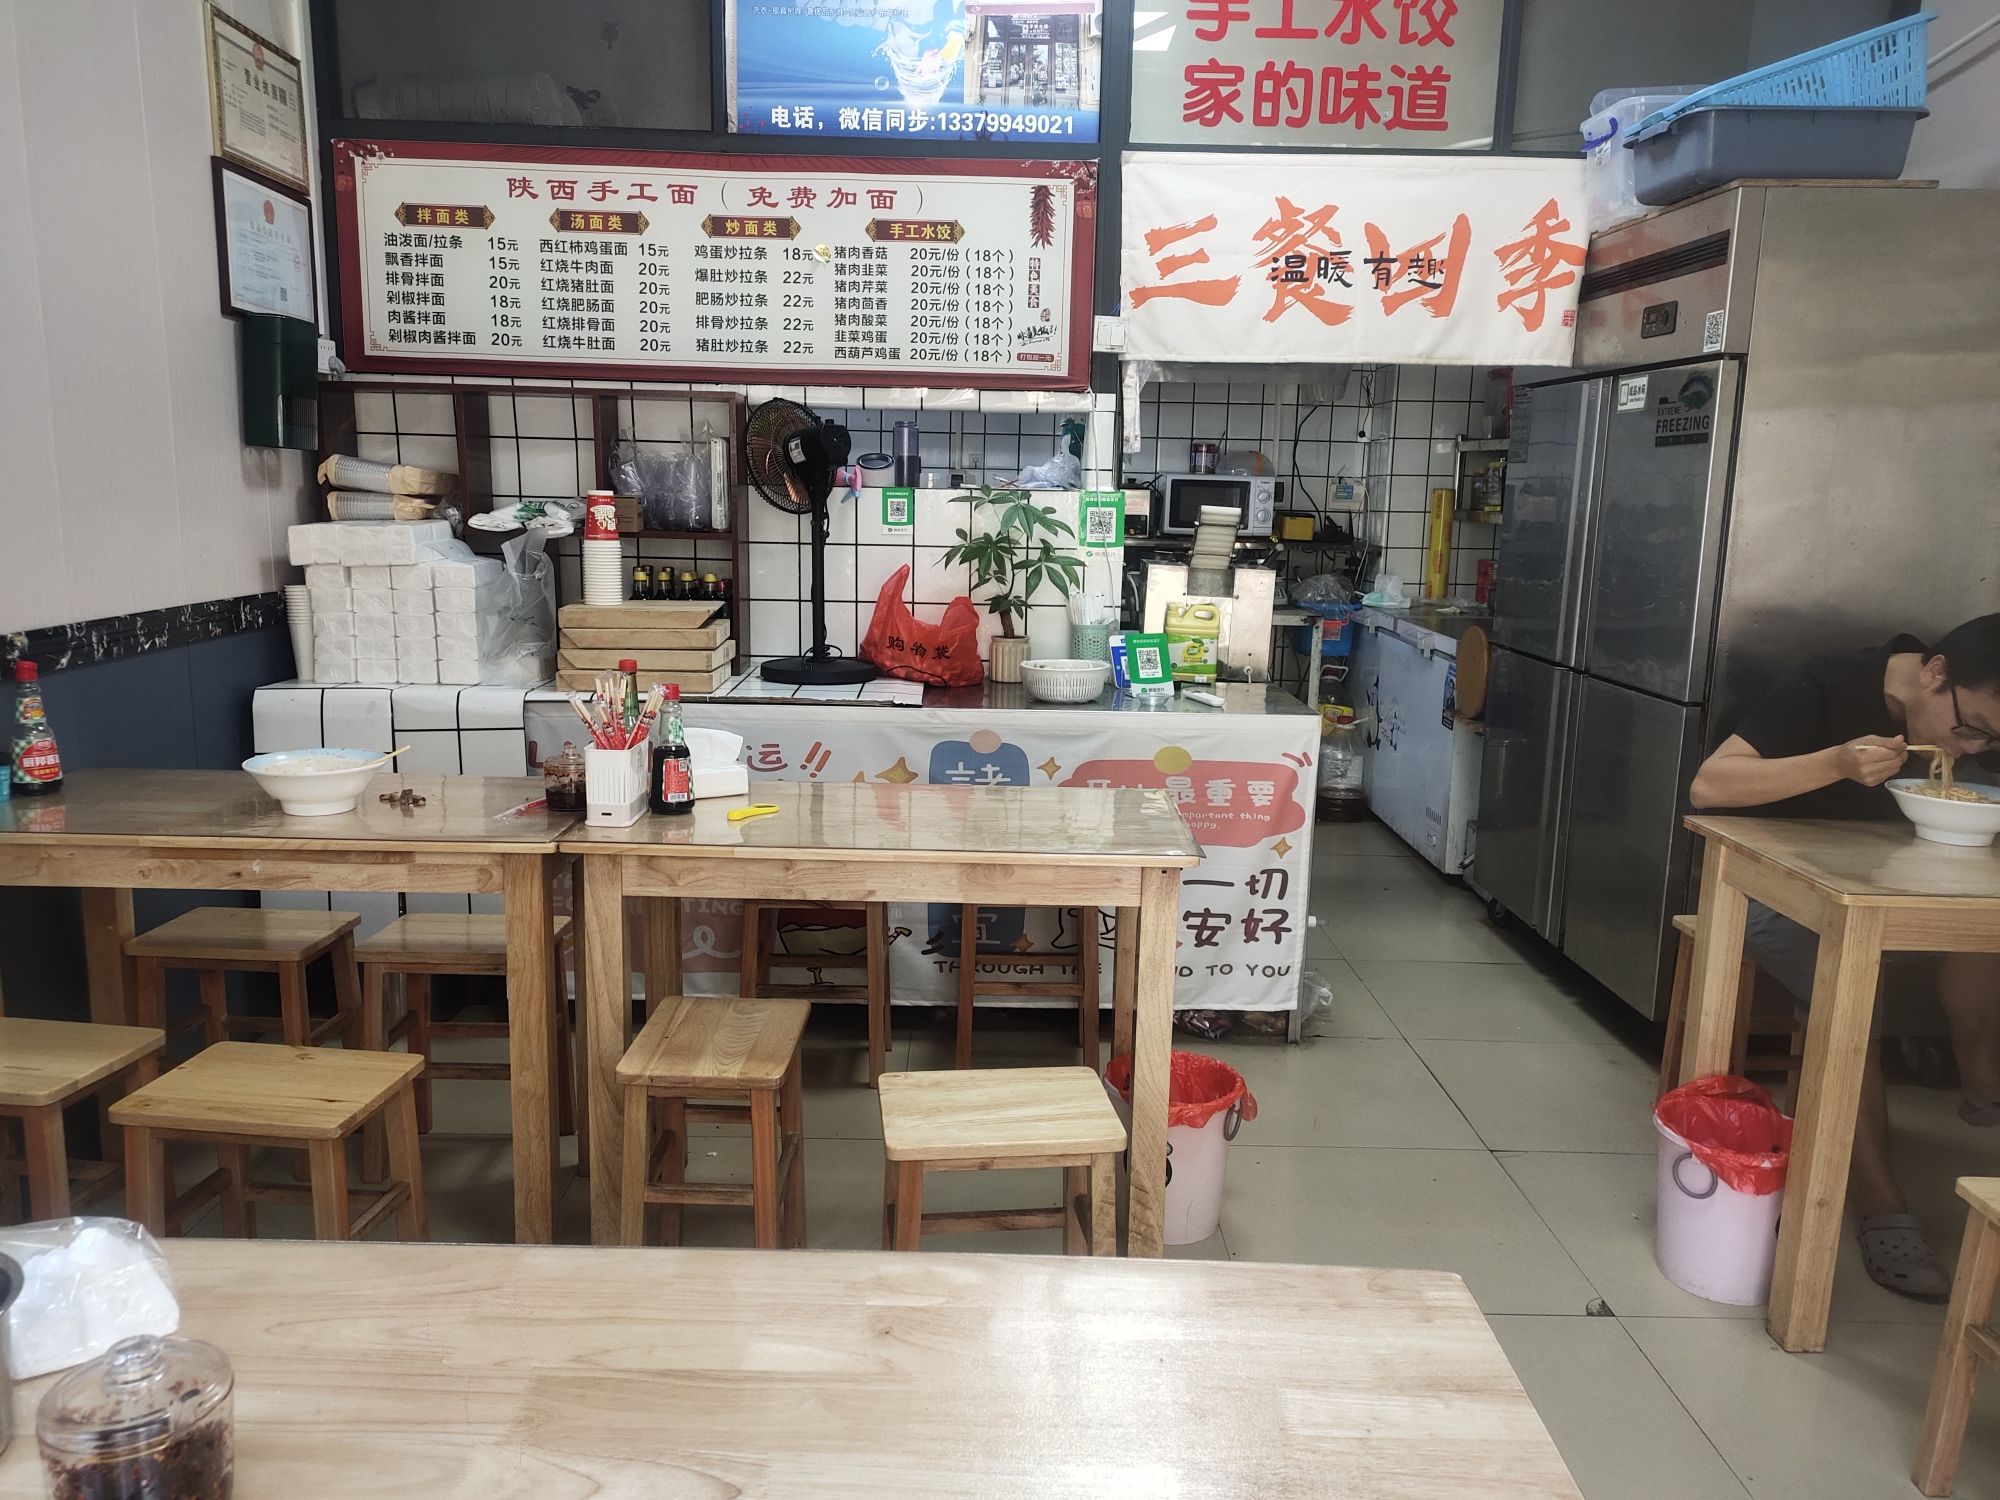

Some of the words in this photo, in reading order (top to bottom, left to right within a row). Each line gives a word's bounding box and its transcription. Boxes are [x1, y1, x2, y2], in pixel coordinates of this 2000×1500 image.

[1183, 57, 1452, 131] 家的味道
[416, 207, 469, 225] 拌面类
[570, 212, 623, 231] 汤面类
[725, 218, 778, 237] 炒面类
[889, 223, 952, 241] 手工水饺
[384, 232, 462, 249] 油泼面/拉条
[488, 237, 518, 251] 15元
[539, 239, 627, 256] 西红柿鸡蛋面
[639, 243, 668, 257] 15元
[385, 252, 443, 268] 飘香拌面
[489, 256, 519, 270] 15元
[695, 245, 767, 260] 鸡蛋炒拉条
[783, 248, 813, 260] 18元
[835, 246, 887, 259] 猪肉香菇
[540, 258, 613, 274] 红烧牛肉面
[639, 263, 669, 276] 20元
[835, 263, 887, 276] 猪肉韭菜
[1129, 196, 1587, 332] 三餐四季
[1271, 250, 1445, 290] 温暖有趣
[386, 271, 444, 287] 排骨拌面
[490, 276, 520, 289] 20元
[695, 268, 767, 283] 爆肚炒拉条
[783, 271, 813, 284] 22元
[541, 278, 614, 294] 红烧猪肚面
[639, 282, 670, 295] 20元
[835, 280, 887, 293] 猪肉芹菜
[387, 290, 445, 306] 剁椒拌面
[491, 295, 521, 308] 18元
[542, 297, 614, 313] 红烧肥肠面
[640, 301, 670, 314] 20元
[696, 292, 768, 307] 肥肠炒拉条
[783, 295, 813, 307] 22元
[835, 297, 887, 310] 猪肉茴香
[388, 309, 446, 325] 肉酱拌面
[491, 314, 521, 328] 18元
[542, 316, 615, 332] 红烧排骨面
[640, 320, 670, 333] 20元
[696, 315, 768, 330] 排骨炒拉条
[783, 318, 813, 331] 22元
[835, 313, 887, 326] 猪肉酸菜
[387, 328, 476, 345] 剁椒肉酱拌面
[492, 333, 522, 347] 20元
[543, 335, 615, 350] 红烧牛肚面
[640, 339, 670, 352] 20元
[835, 330, 887, 343] 韭菜鸡蛋
[696, 338, 768, 353] 猪肚炒拉条
[783, 341, 813, 354] 22元
[835, 347, 900, 360] 西葫芦鸡蛋
[1656, 415, 1710, 433] FREEZING
[886, 635, 951, 660] 购物袋
[1182, 811, 1234, 821] mportant
[1240, 812, 1271, 821] thing
[1188, 822, 1221, 830] appy.
[1182, 868, 1289, 900] 一切
[1182, 907, 1292, 948] 安好
[1205, 963, 1234, 977] TO
[1246, 963, 1291, 978] YOU
